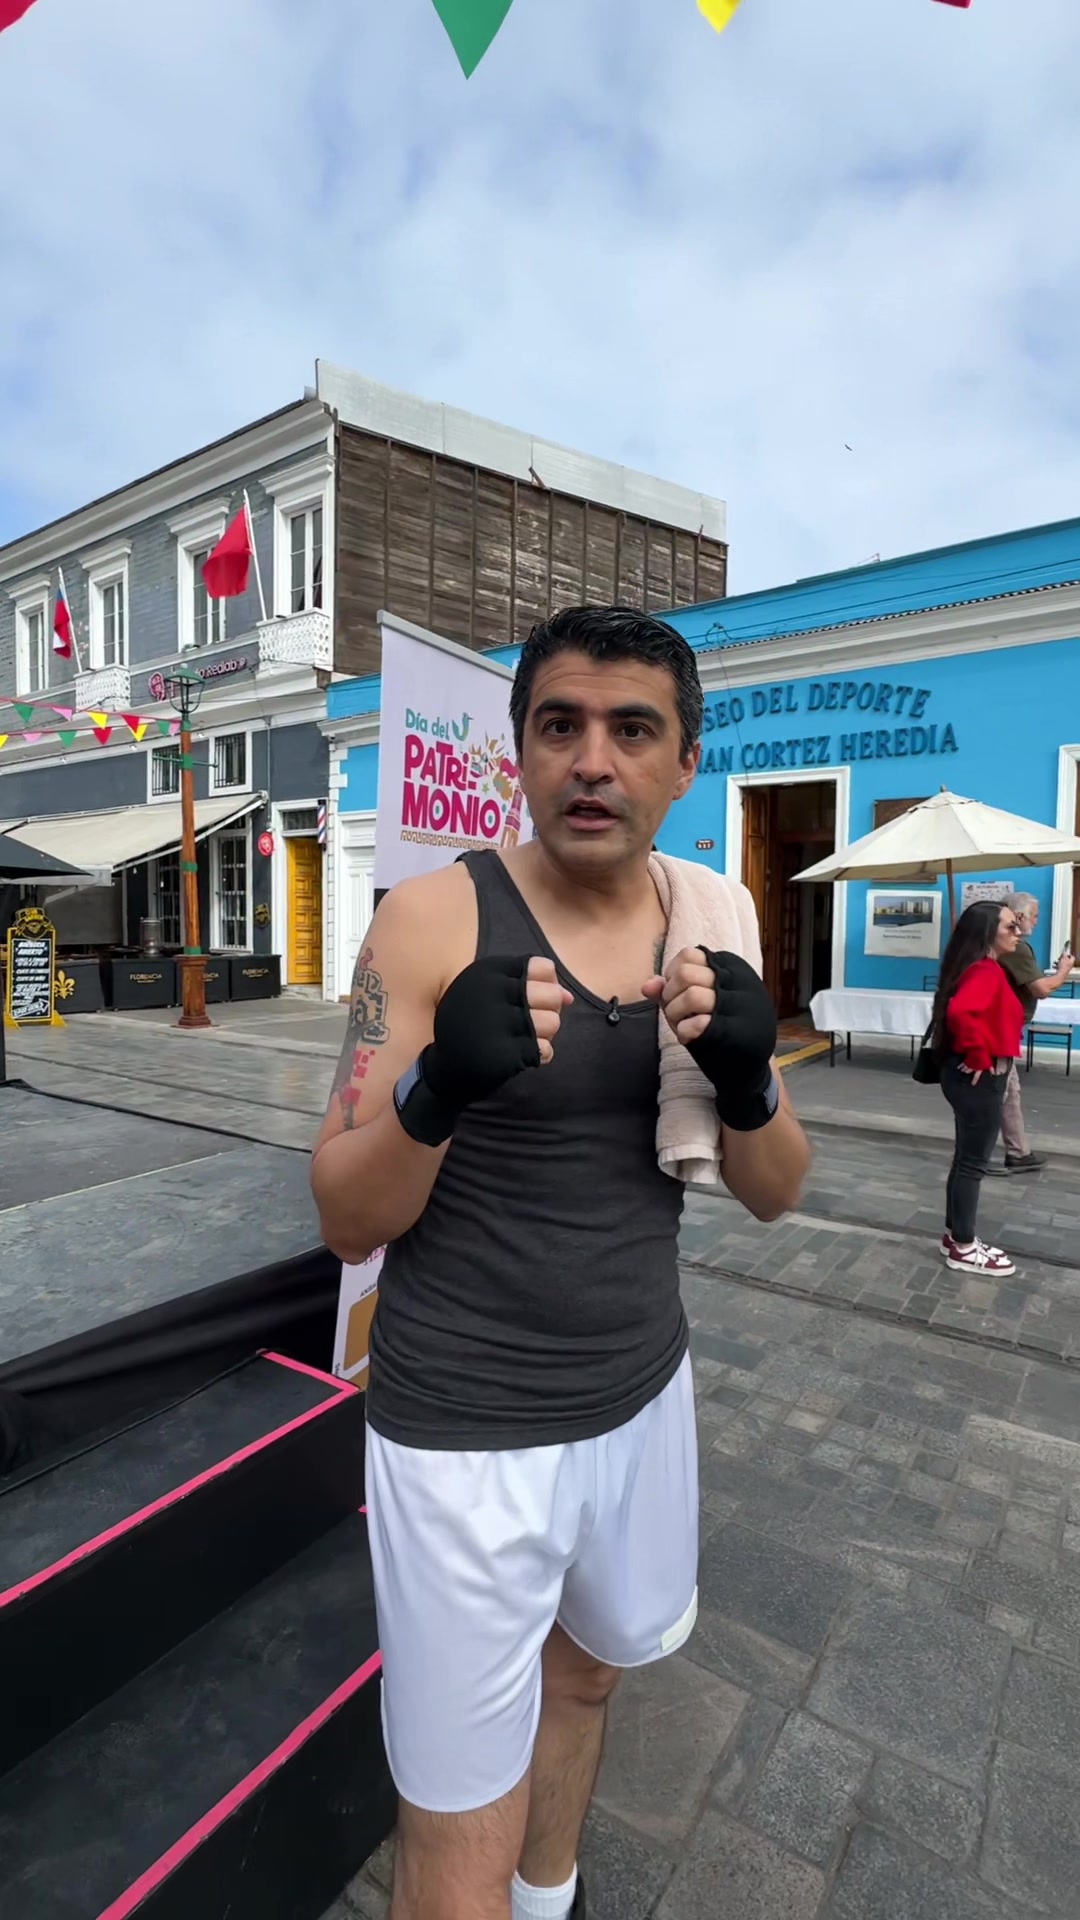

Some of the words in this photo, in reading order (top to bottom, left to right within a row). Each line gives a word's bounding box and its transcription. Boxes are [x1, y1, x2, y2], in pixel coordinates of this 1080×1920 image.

[405, 708, 428, 733] Día
[431, 717, 450, 741] del
[703, 697, 745, 733] SEO
[752, 684, 798, 718] DEL
[807, 681, 931, 720] DEPORTE
[741, 735, 831, 770] CORTEZ
[840, 722, 959, 762] HEREDIA
[401, 780, 501, 839] MONIO
